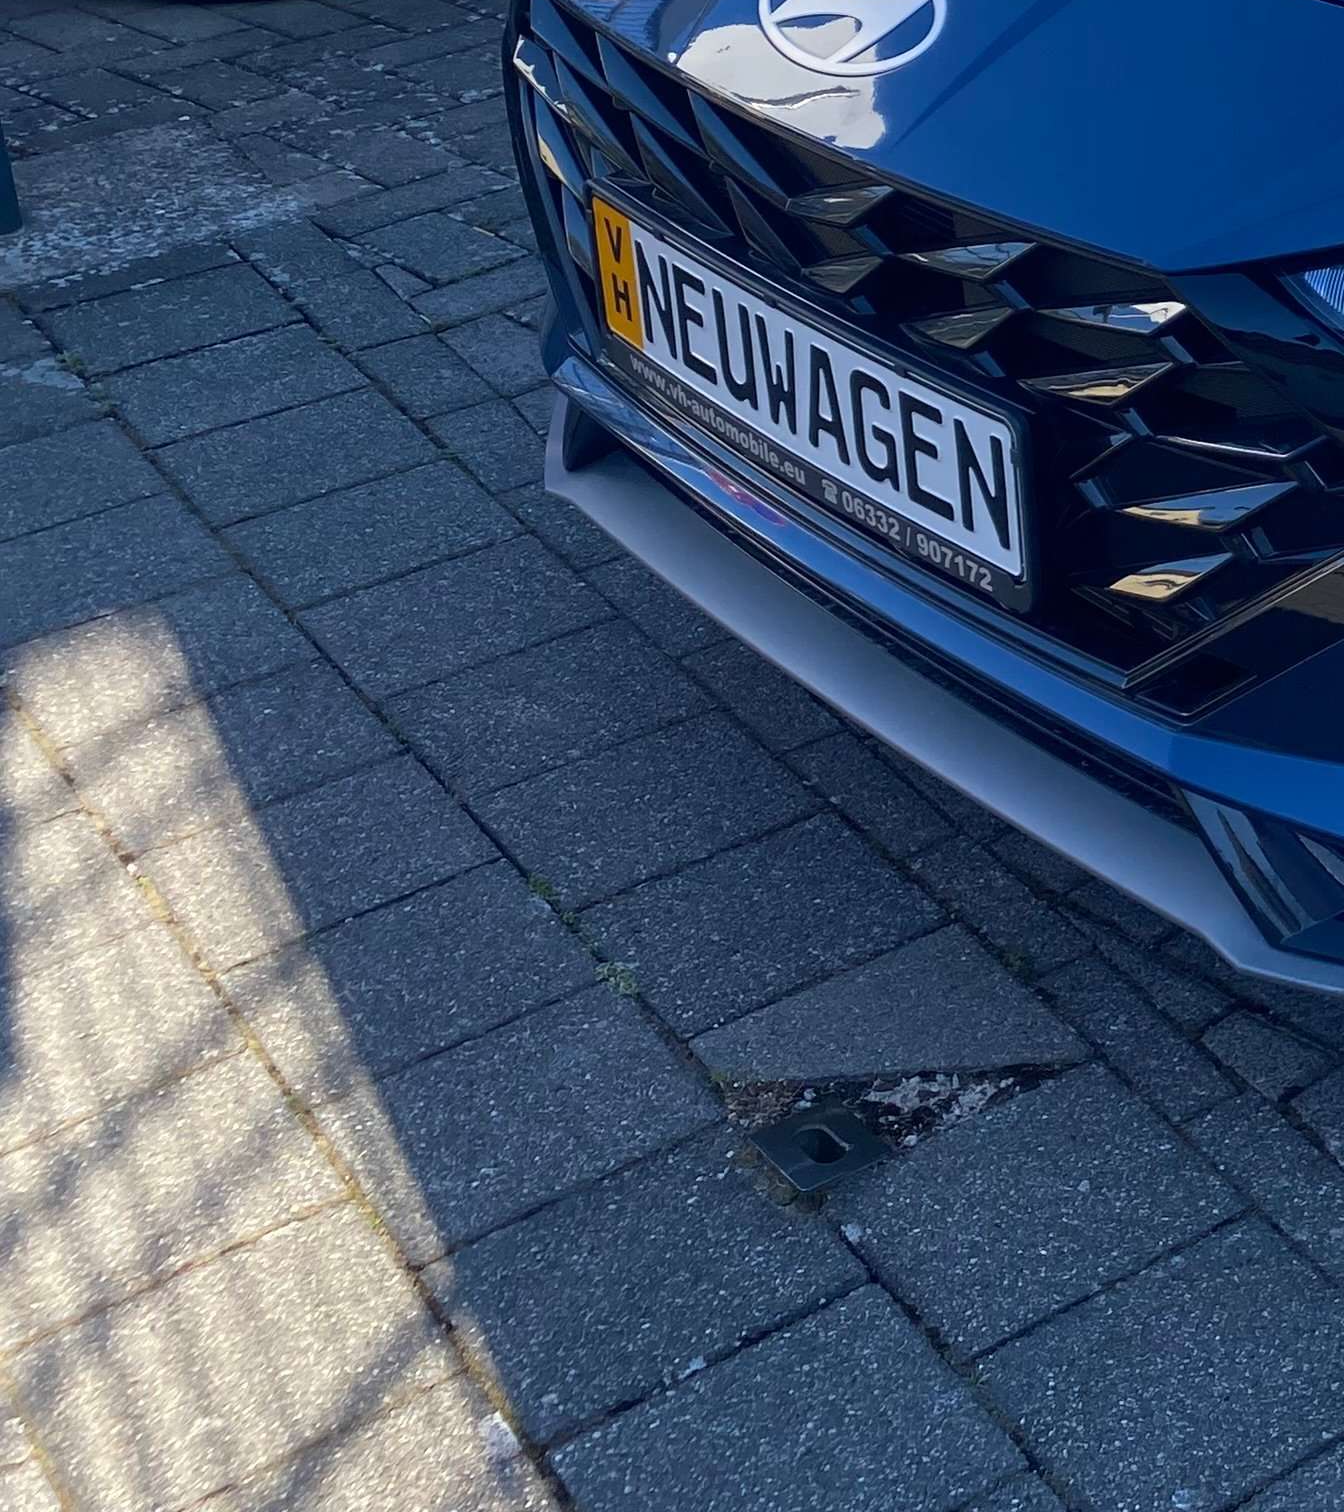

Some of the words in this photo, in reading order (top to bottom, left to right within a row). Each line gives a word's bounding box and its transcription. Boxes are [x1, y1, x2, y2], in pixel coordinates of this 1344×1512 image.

[629, 352, 807, 486] www.vh-automobile.eu
[841, 490, 902, 541] 06332
[916, 532, 994, 593] 907172
[635, 239, 1011, 552] NEUWAGEN
